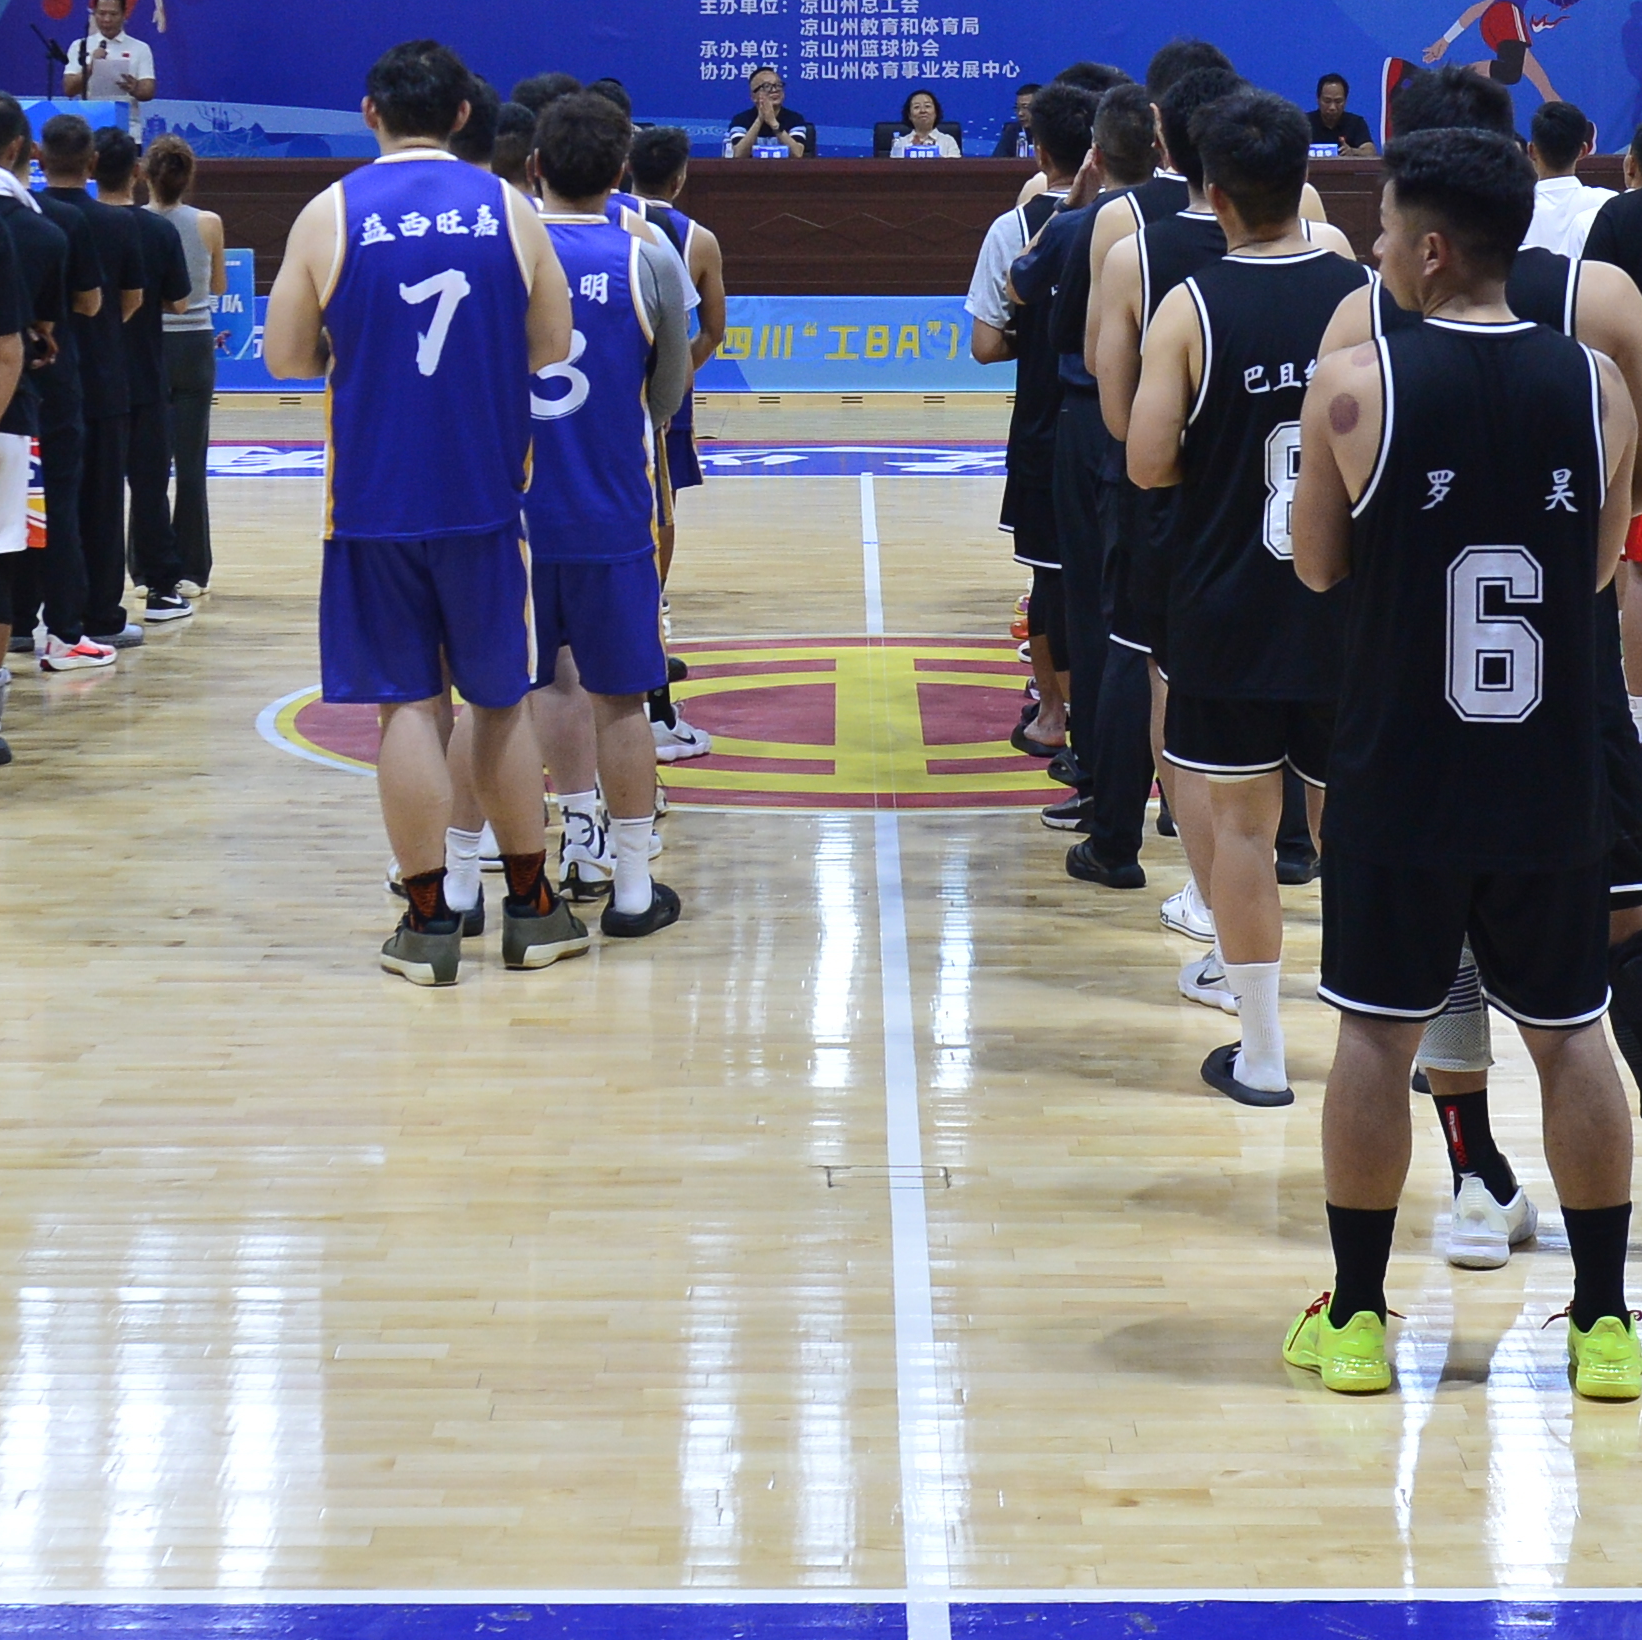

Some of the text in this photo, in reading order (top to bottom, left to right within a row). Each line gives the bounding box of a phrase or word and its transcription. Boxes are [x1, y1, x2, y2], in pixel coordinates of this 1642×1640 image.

[800, 16, 980, 37] 凉山州教育和体育局
[399, 268, 472, 377] 7
[1445, 544, 1544, 723] 6
